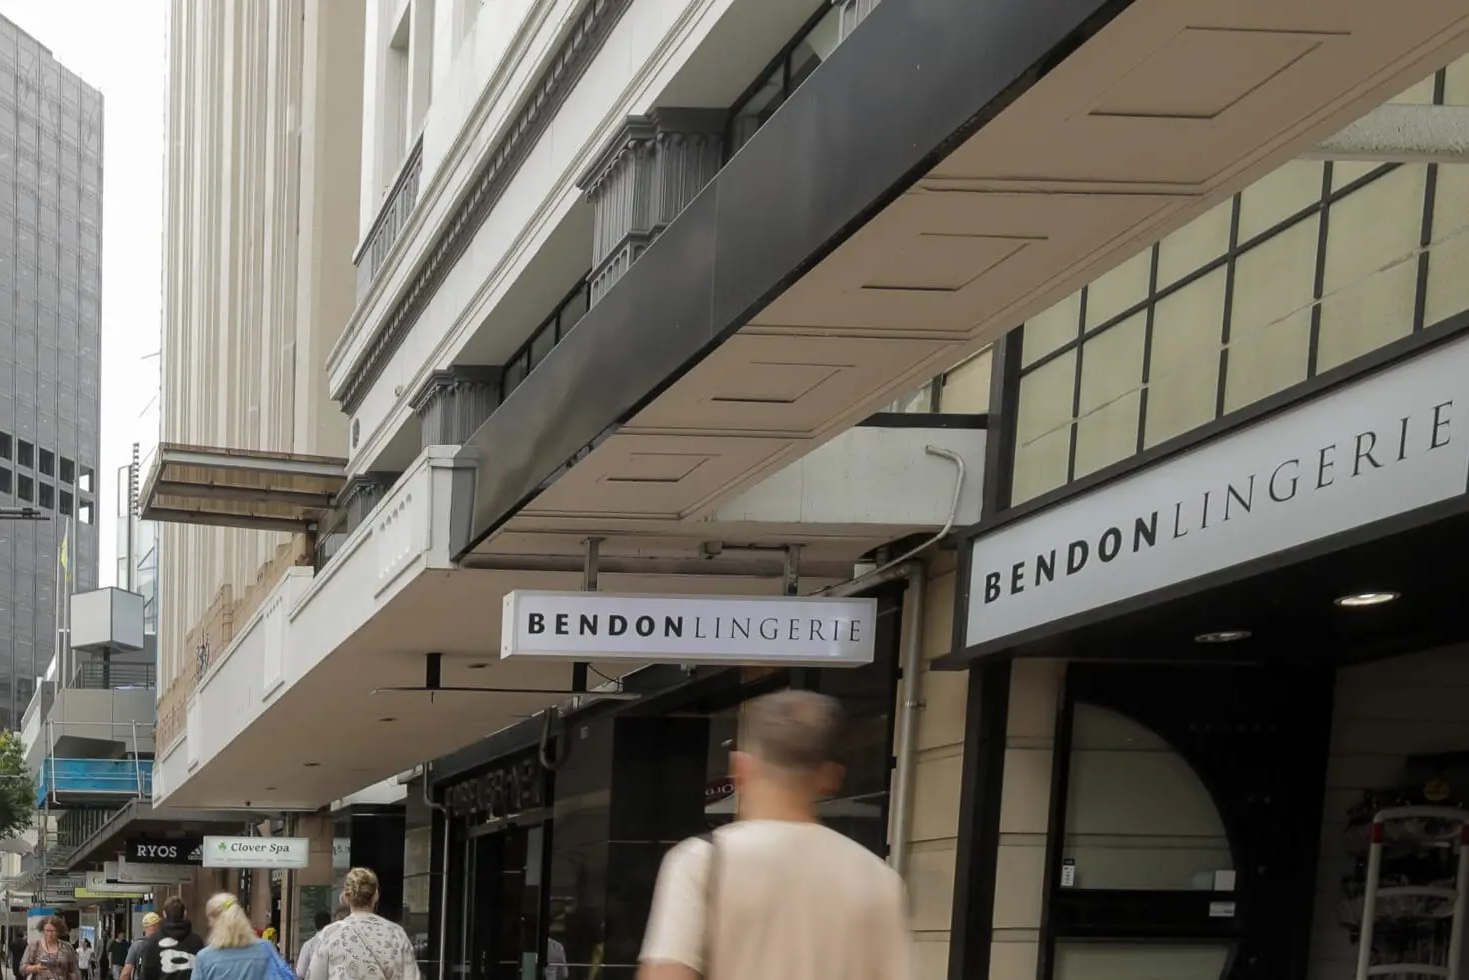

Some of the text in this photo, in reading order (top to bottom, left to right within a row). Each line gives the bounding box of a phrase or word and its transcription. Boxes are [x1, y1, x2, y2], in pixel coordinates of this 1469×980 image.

[984, 400, 1454, 604] BENDON LINGERIE
[528, 612, 862, 642] BENDON LINGERIE
[137, 844, 178, 858] RYOS
[231, 842, 290, 854] Clover Spa
